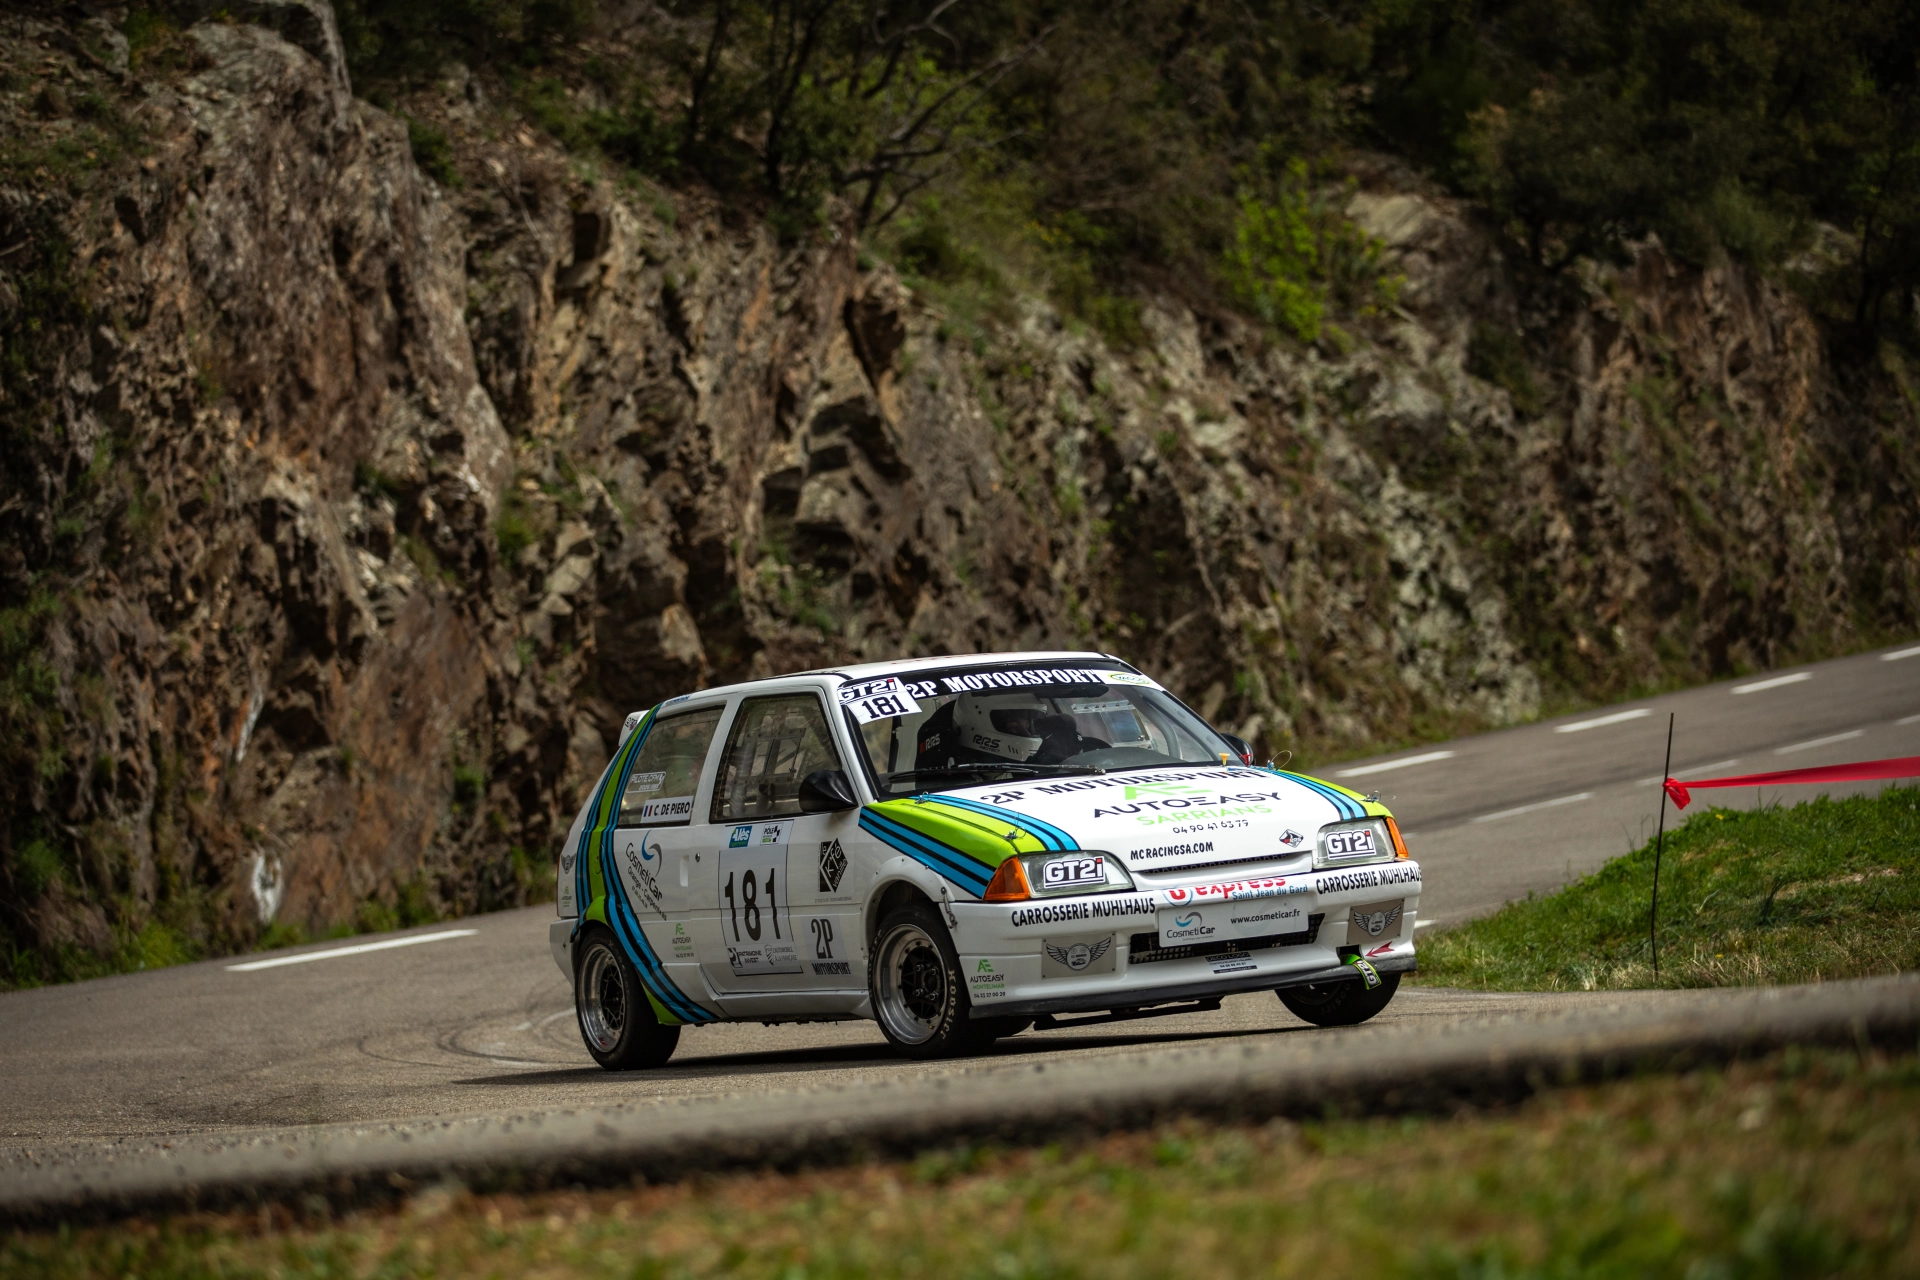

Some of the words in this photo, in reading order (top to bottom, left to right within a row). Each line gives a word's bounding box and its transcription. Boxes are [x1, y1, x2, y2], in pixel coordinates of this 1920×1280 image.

[838, 678, 896, 701] GT2i
[904, 681, 938, 698] 2P
[940, 668, 1101, 693] MOTORSPORT
[861, 695, 909, 719] 181
[926, 733, 940, 750] RRS
[972, 734, 1001, 748] RRS
[660, 803, 670, 816] DE
[670, 801, 690, 815] PIERO
[980, 791, 1026, 804] 2P
[1094, 792, 1282, 818] AUTOEASY
[1136, 804, 1273, 825] SARRIANS
[1172, 826, 1188, 834] 04
[1189, 824, 1204, 833] 90
[1326, 830, 1374, 853] GT2i
[625, 842, 663, 901] CosmetiCar
[1045, 858, 1103, 881] GT2i
[1232, 889, 1254, 900] Saint
[1256, 887, 1275, 898] Jean
[1277, 886, 1287, 896] du
[1289, 884, 1308, 894] Gard
[1316, 871, 1378, 895] CARROSSERIE
[725, 868, 781, 942] 181
[1011, 902, 1089, 927] CARROSSERIE
[1092, 897, 1155, 918] MUHLHAUS
[1230, 909, 1301, 924] www.cosmeticar.fr
[811, 919, 834, 959] 2P
[1166, 926, 1216, 939] CosmetiCar
[811, 962, 852, 975] MOTORSPORT
[970, 974, 1004, 983] AUTOEASY
